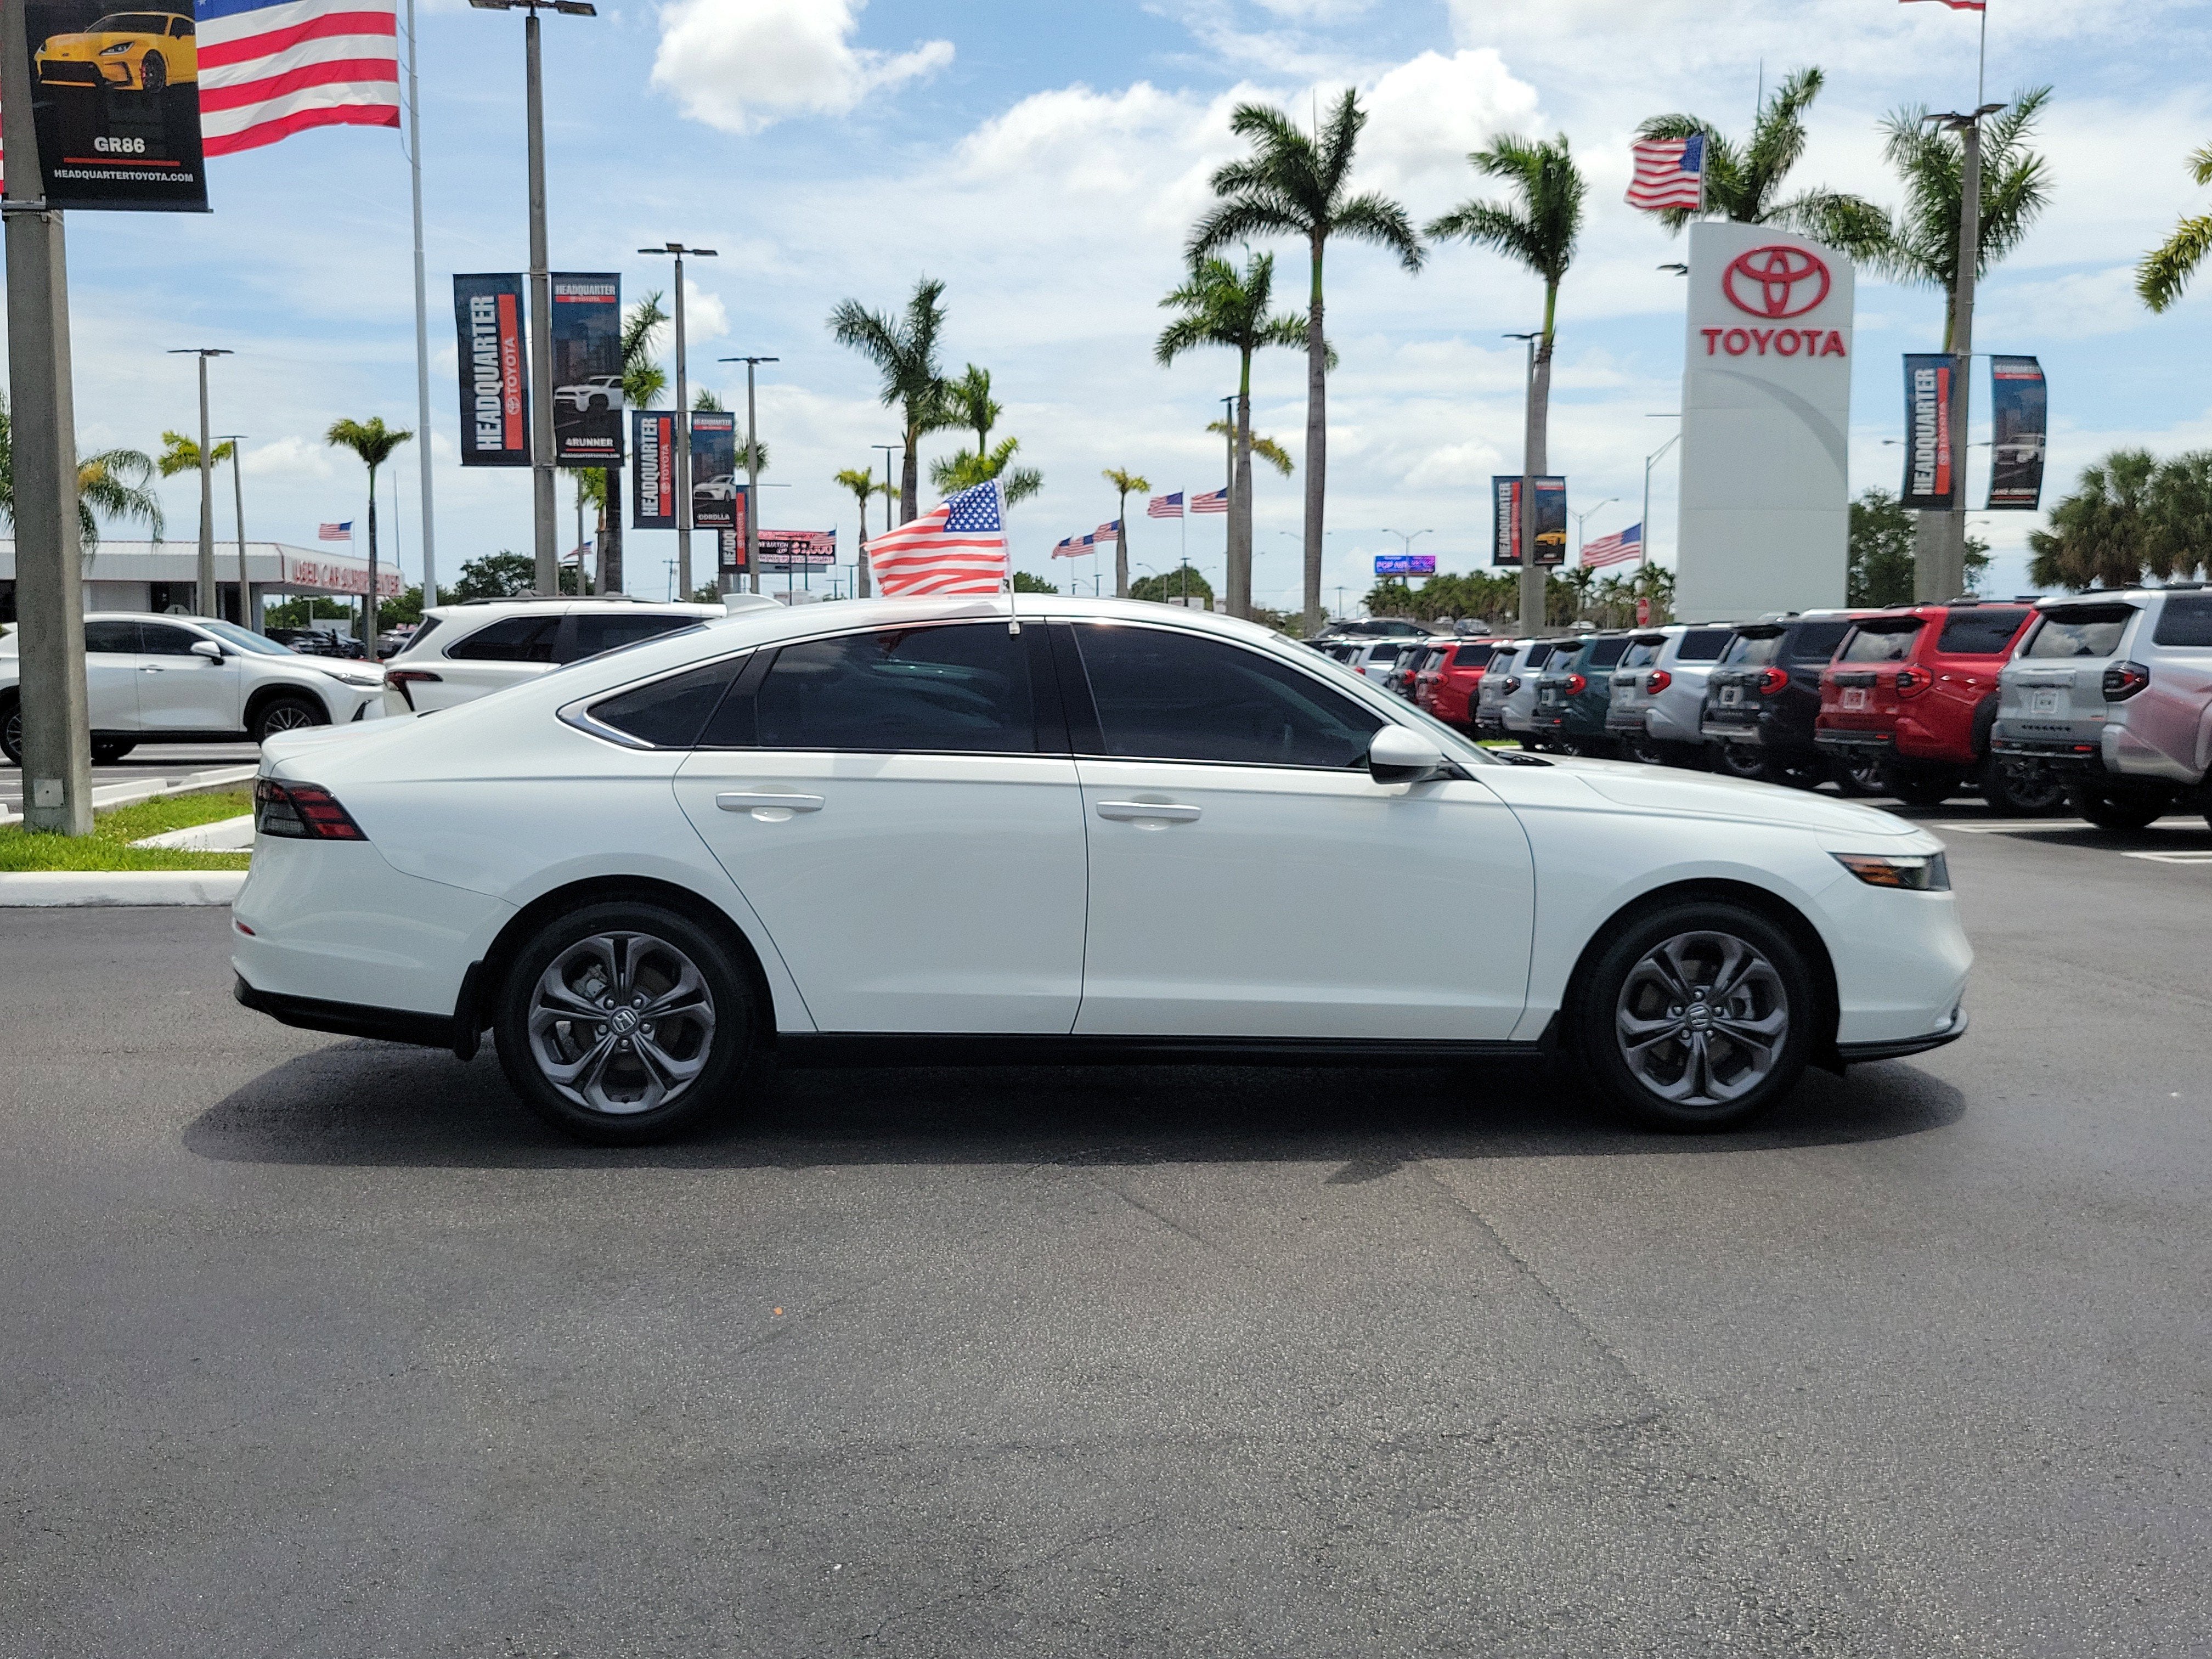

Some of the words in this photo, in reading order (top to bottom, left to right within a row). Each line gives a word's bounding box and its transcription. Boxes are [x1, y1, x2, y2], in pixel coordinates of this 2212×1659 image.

[94, 137, 145, 153] GR86
[54, 169, 194, 182] HEADQUARTERTOYOTA.COM
[555, 284, 616, 296] HEADQUARTER
[1701, 329, 1846, 357] TOYOTA
[470, 295, 504, 450] HEADQUARTER
[503, 337, 520, 394] TOYOTA
[565, 437, 614, 447] 4RUNNER
[1912, 368, 1938, 495] HEADQUARTER
[641, 417, 661, 517] HEADQUARTER
[661, 444, 670, 481] TOYOTA
[1498, 482, 1511, 558] HEADQUARTER
[294, 560, 317, 585] USED
